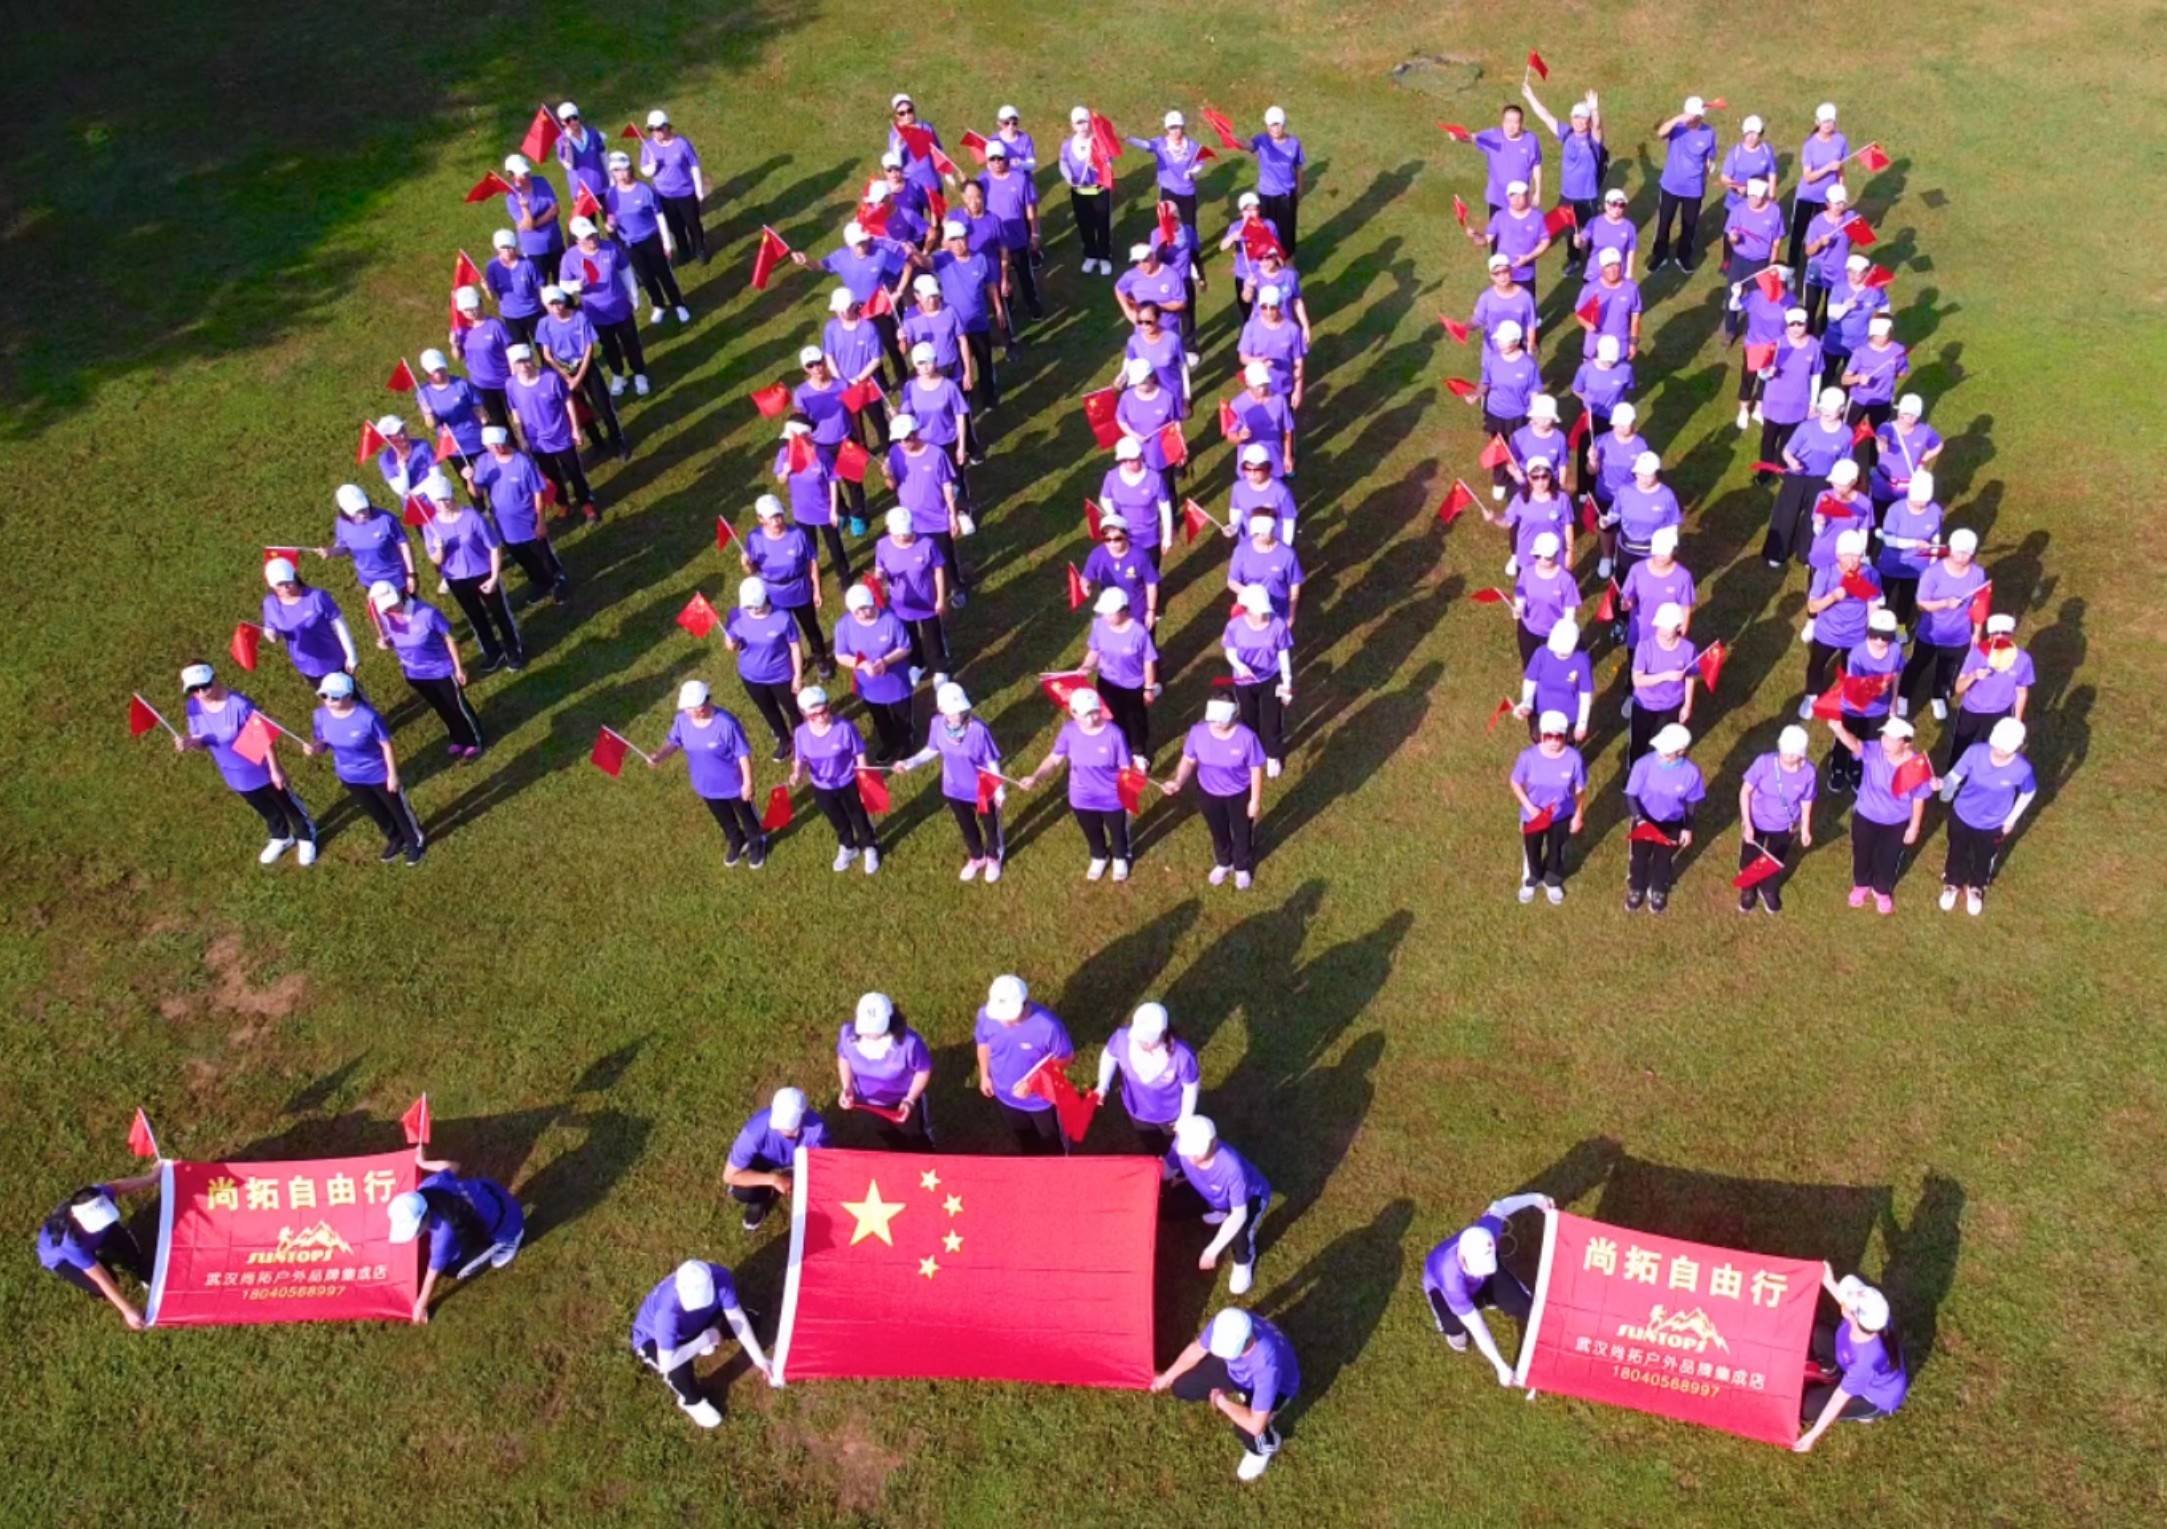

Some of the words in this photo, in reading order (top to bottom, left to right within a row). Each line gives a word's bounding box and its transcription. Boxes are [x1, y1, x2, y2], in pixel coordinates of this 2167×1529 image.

[207, 1170, 396, 1211] 尚拓自由行
[1583, 1236, 1788, 1308] 尚拓自由行
